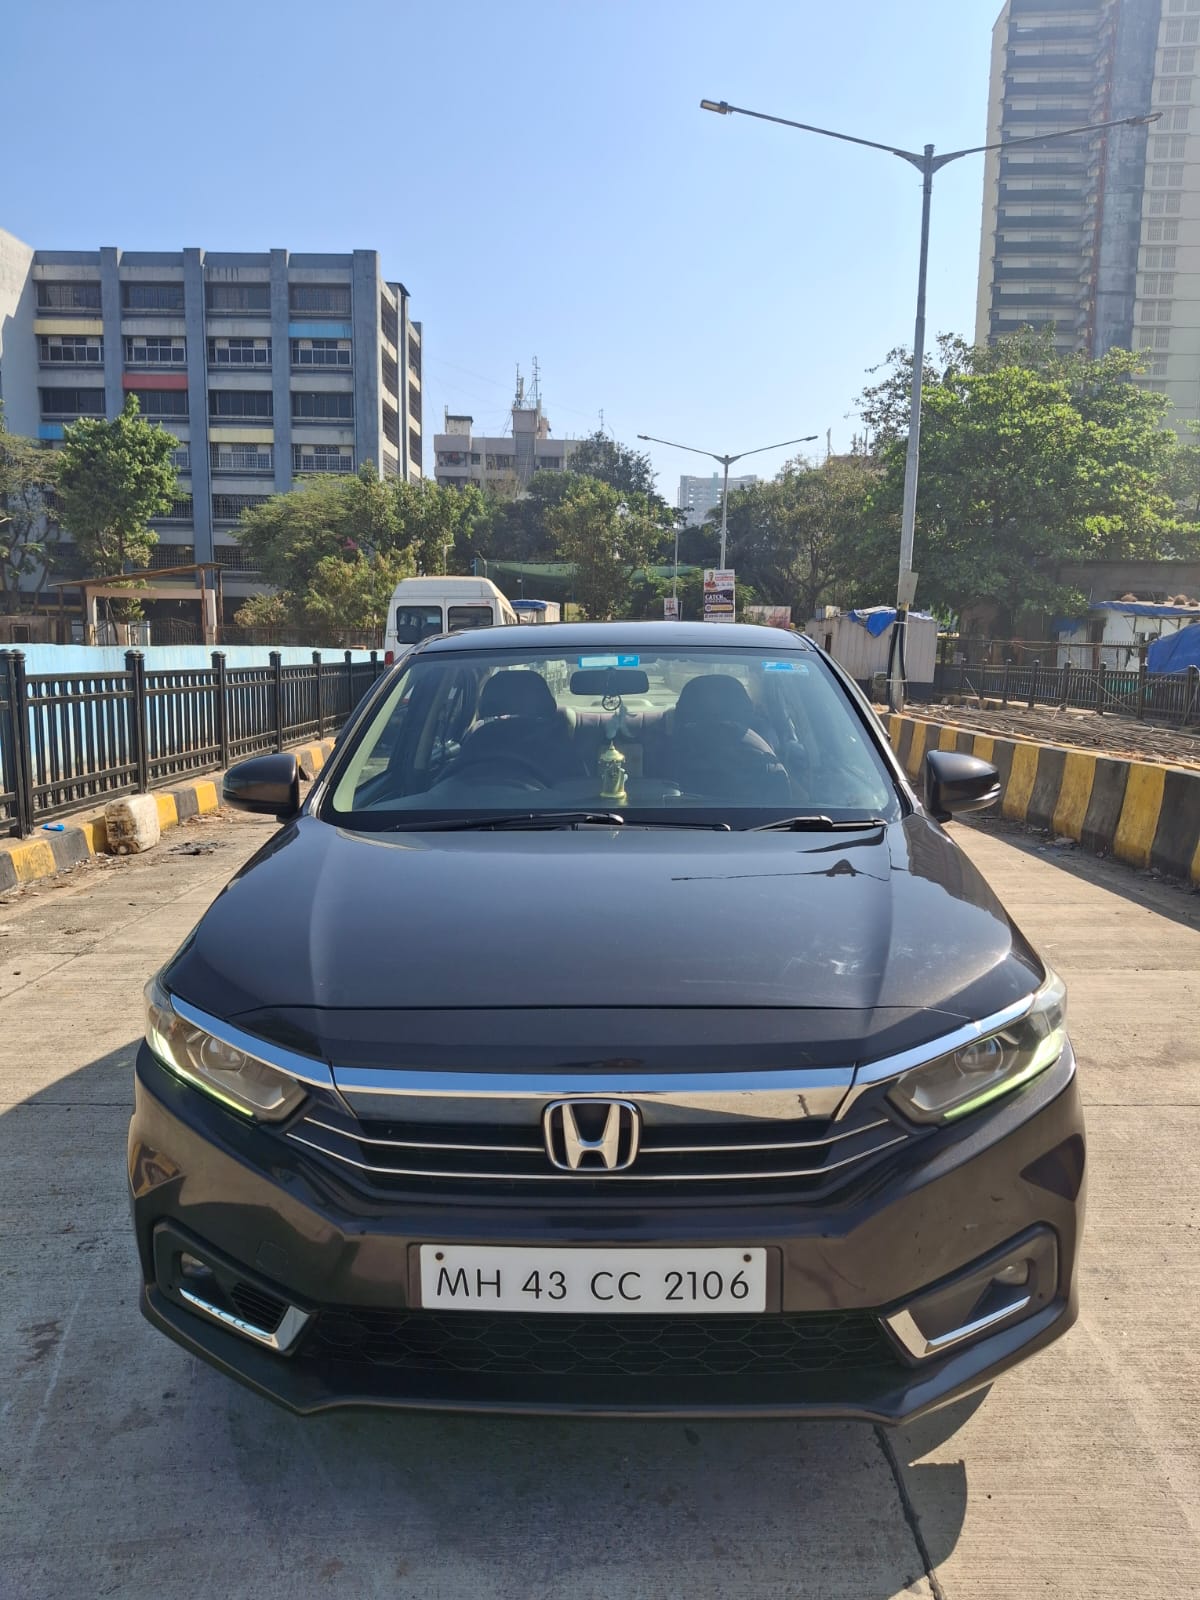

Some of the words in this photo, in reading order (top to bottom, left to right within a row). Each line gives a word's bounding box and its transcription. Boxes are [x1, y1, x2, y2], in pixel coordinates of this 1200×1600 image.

[436, 1266, 501, 1298] MH
[521, 1270, 567, 1300] 43
[590, 1271, 642, 1301] CC
[664, 1269, 750, 1301] 2106
